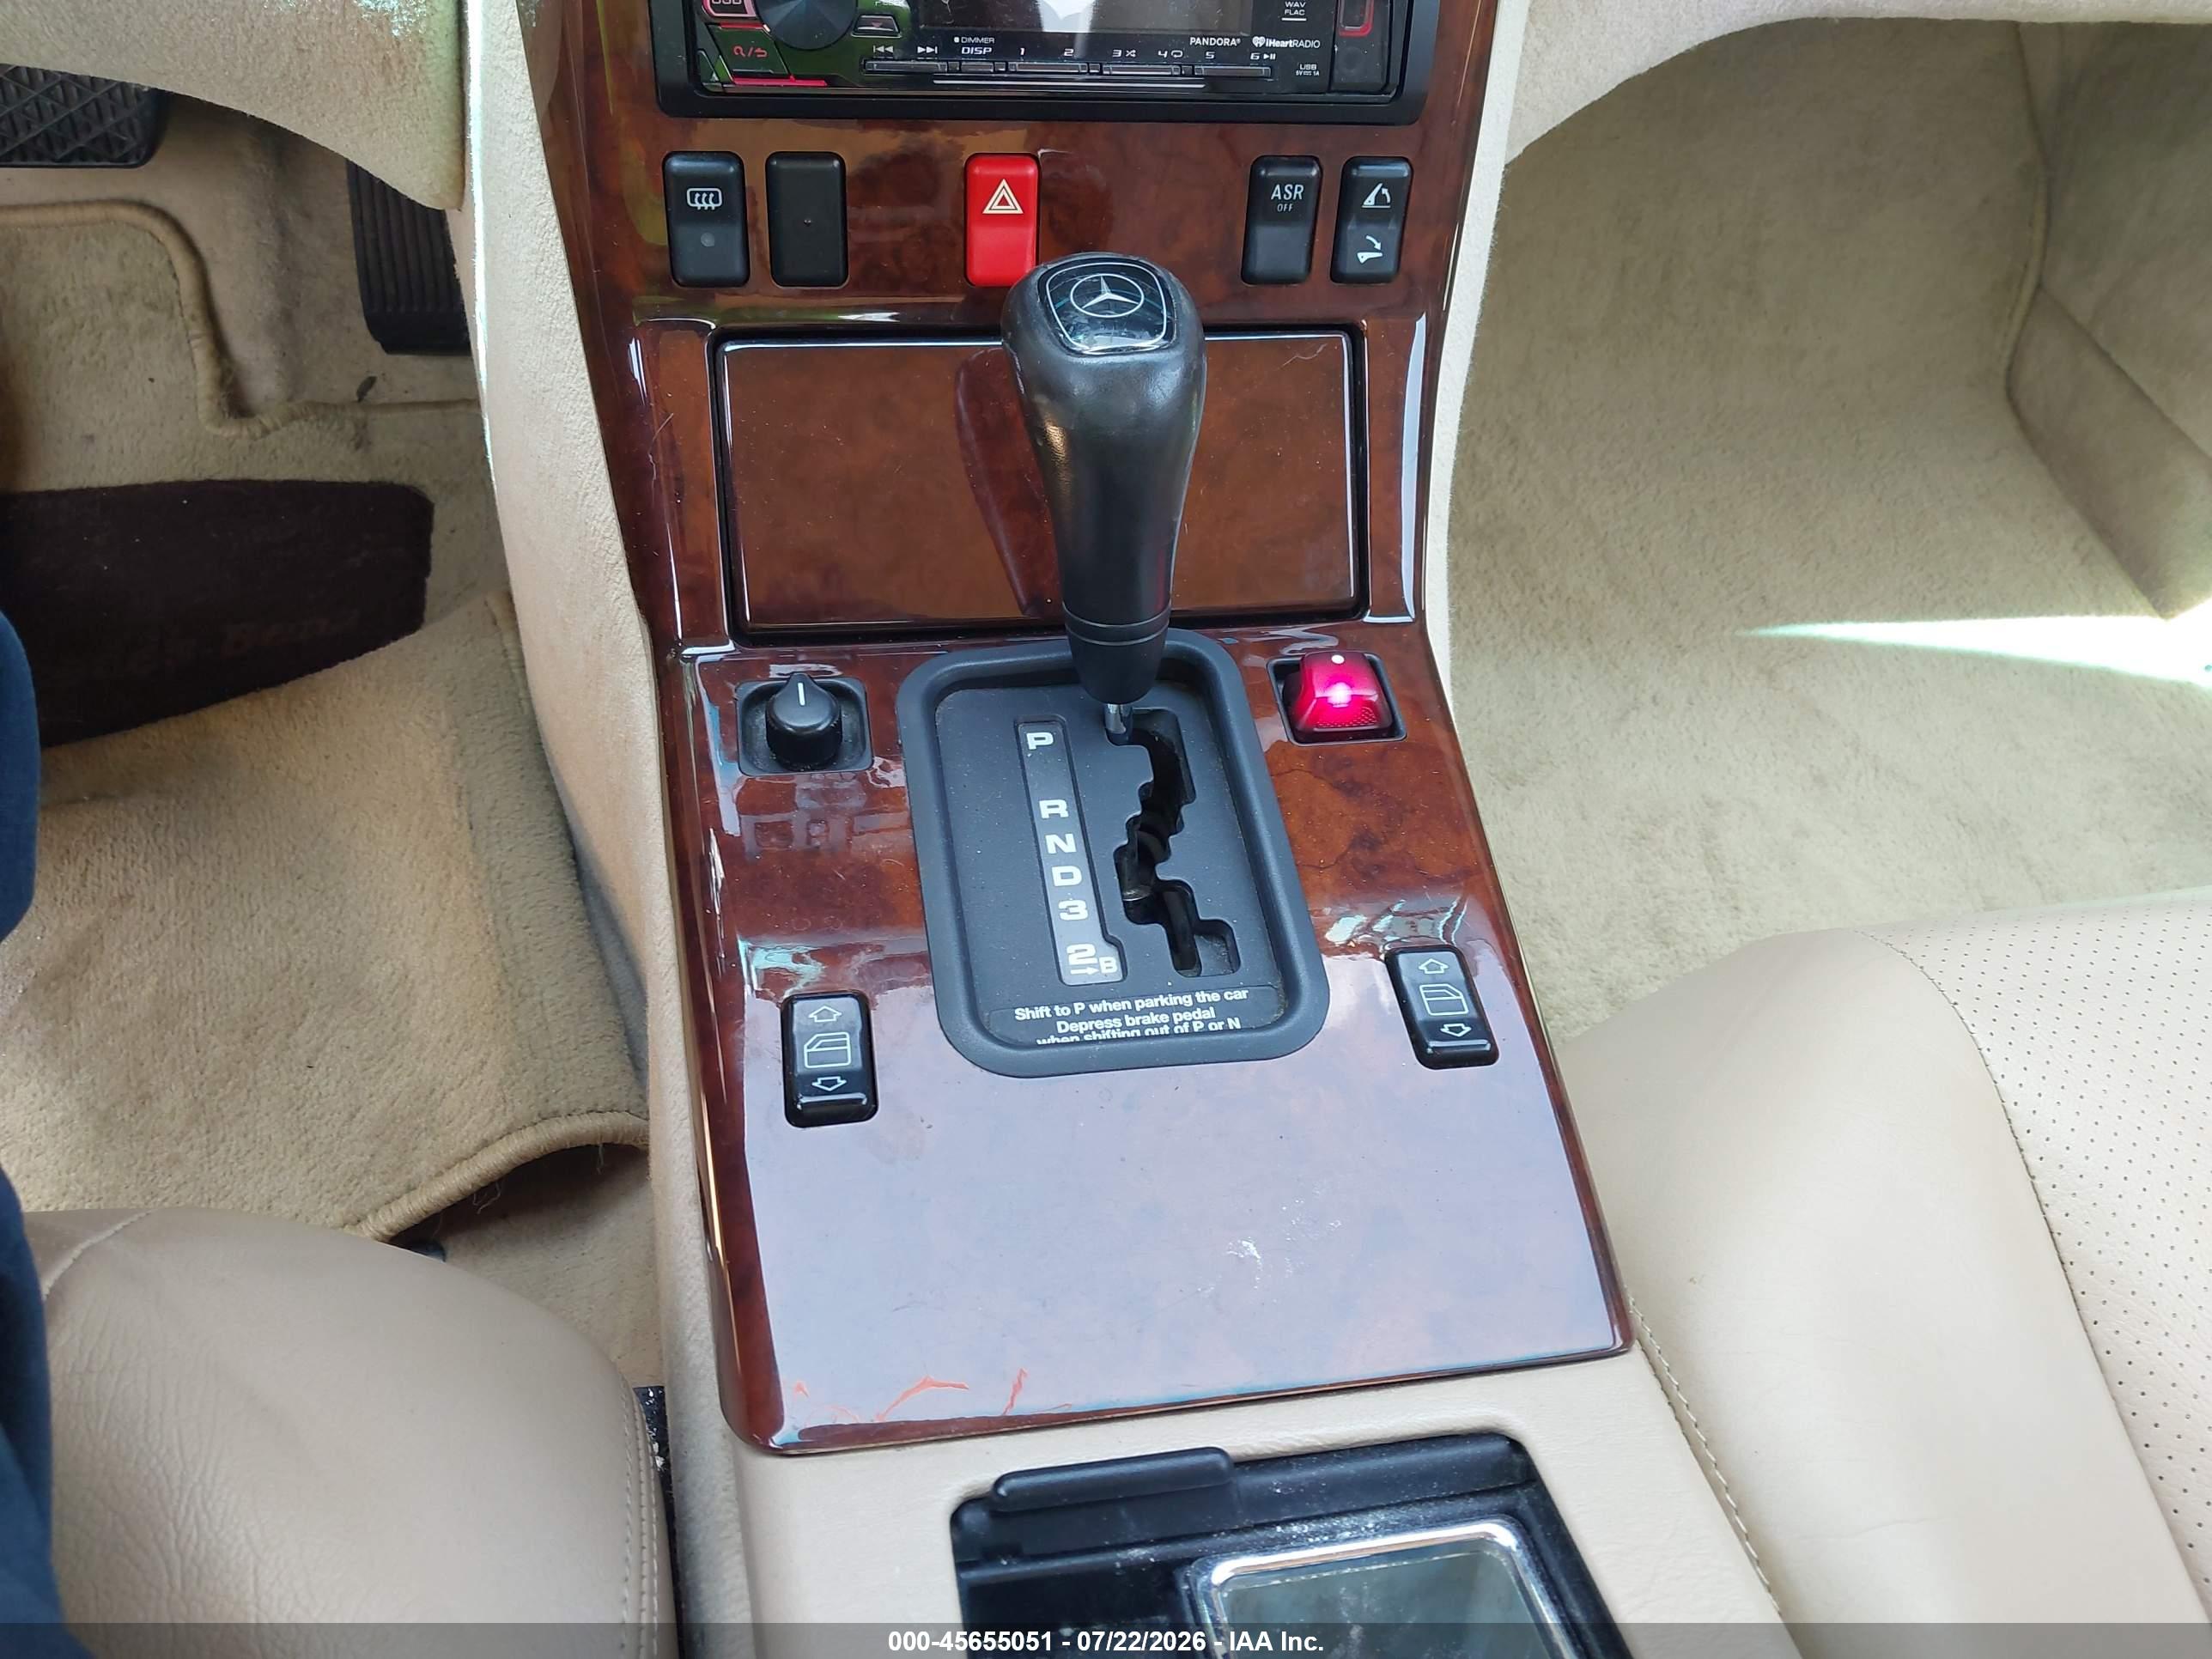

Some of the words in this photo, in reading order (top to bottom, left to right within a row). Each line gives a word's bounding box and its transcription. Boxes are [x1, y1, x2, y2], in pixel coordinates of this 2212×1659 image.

[961, 46, 993, 55] DISP
[1063, 48, 1074, 57] 2
[1112, 49, 1122, 58] 3
[1158, 50, 1168, 58] 4
[1271, 184, 1304, 200] ASR
[1277, 204, 1293, 212] OFF
[1026, 732, 1054, 750] P
[1039, 799, 1069, 819] R
[1046, 833, 1077, 854] N
[1052, 866, 1082, 887] D
[1058, 899, 1088, 921] 3
[1066, 943, 1097, 966] 2
[1099, 956, 1118, 974] B
[1014, 1006, 1052, 1020] Shift
[1054, 1005, 1071, 1016] to
[1073, 1002, 1085, 1014] P
[1089, 1000, 1132, 1013] when
[1134, 994, 1193, 1012] parking
[1194, 990, 1220, 1003] the
[1223, 989, 1249, 1000] car
[1056, 1018, 1122, 1034] Depress
[1125, 1012, 1170, 1027] brake
[1172, 1006, 1216, 1024] pedal
[1173, 1021, 1190, 1034] of
[1192, 1020, 1205, 1032] P
[1208, 1021, 1224, 1030] or
[1226, 1017, 1242, 1030] N
